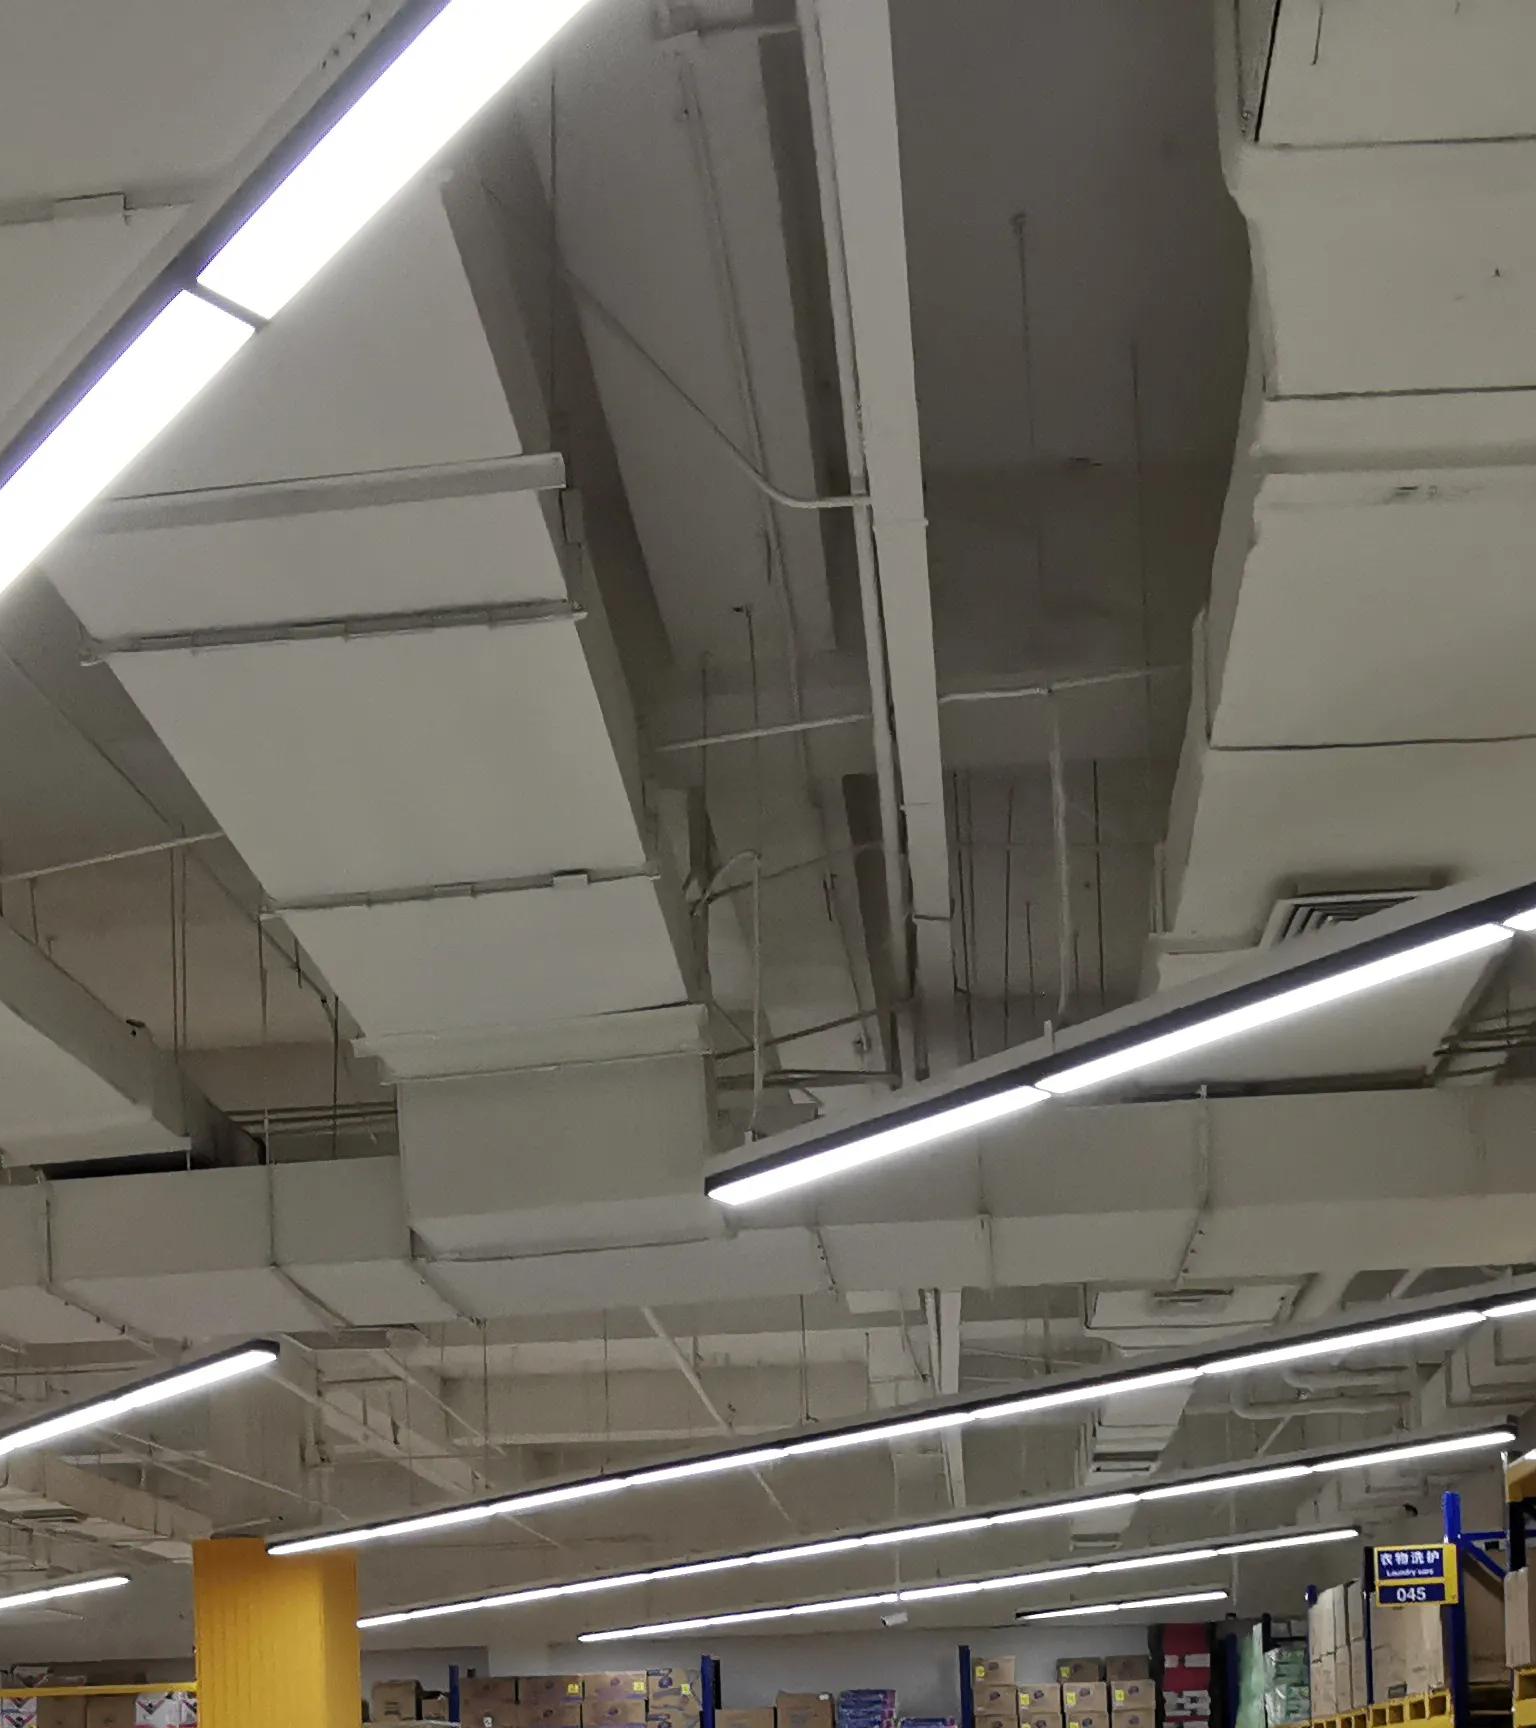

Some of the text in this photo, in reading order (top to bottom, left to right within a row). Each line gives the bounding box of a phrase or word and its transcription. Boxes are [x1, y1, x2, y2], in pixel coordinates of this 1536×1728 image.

[1380, 1550, 1440, 1566] 衣物洗护
[1396, 1586, 1426, 1602] 045
